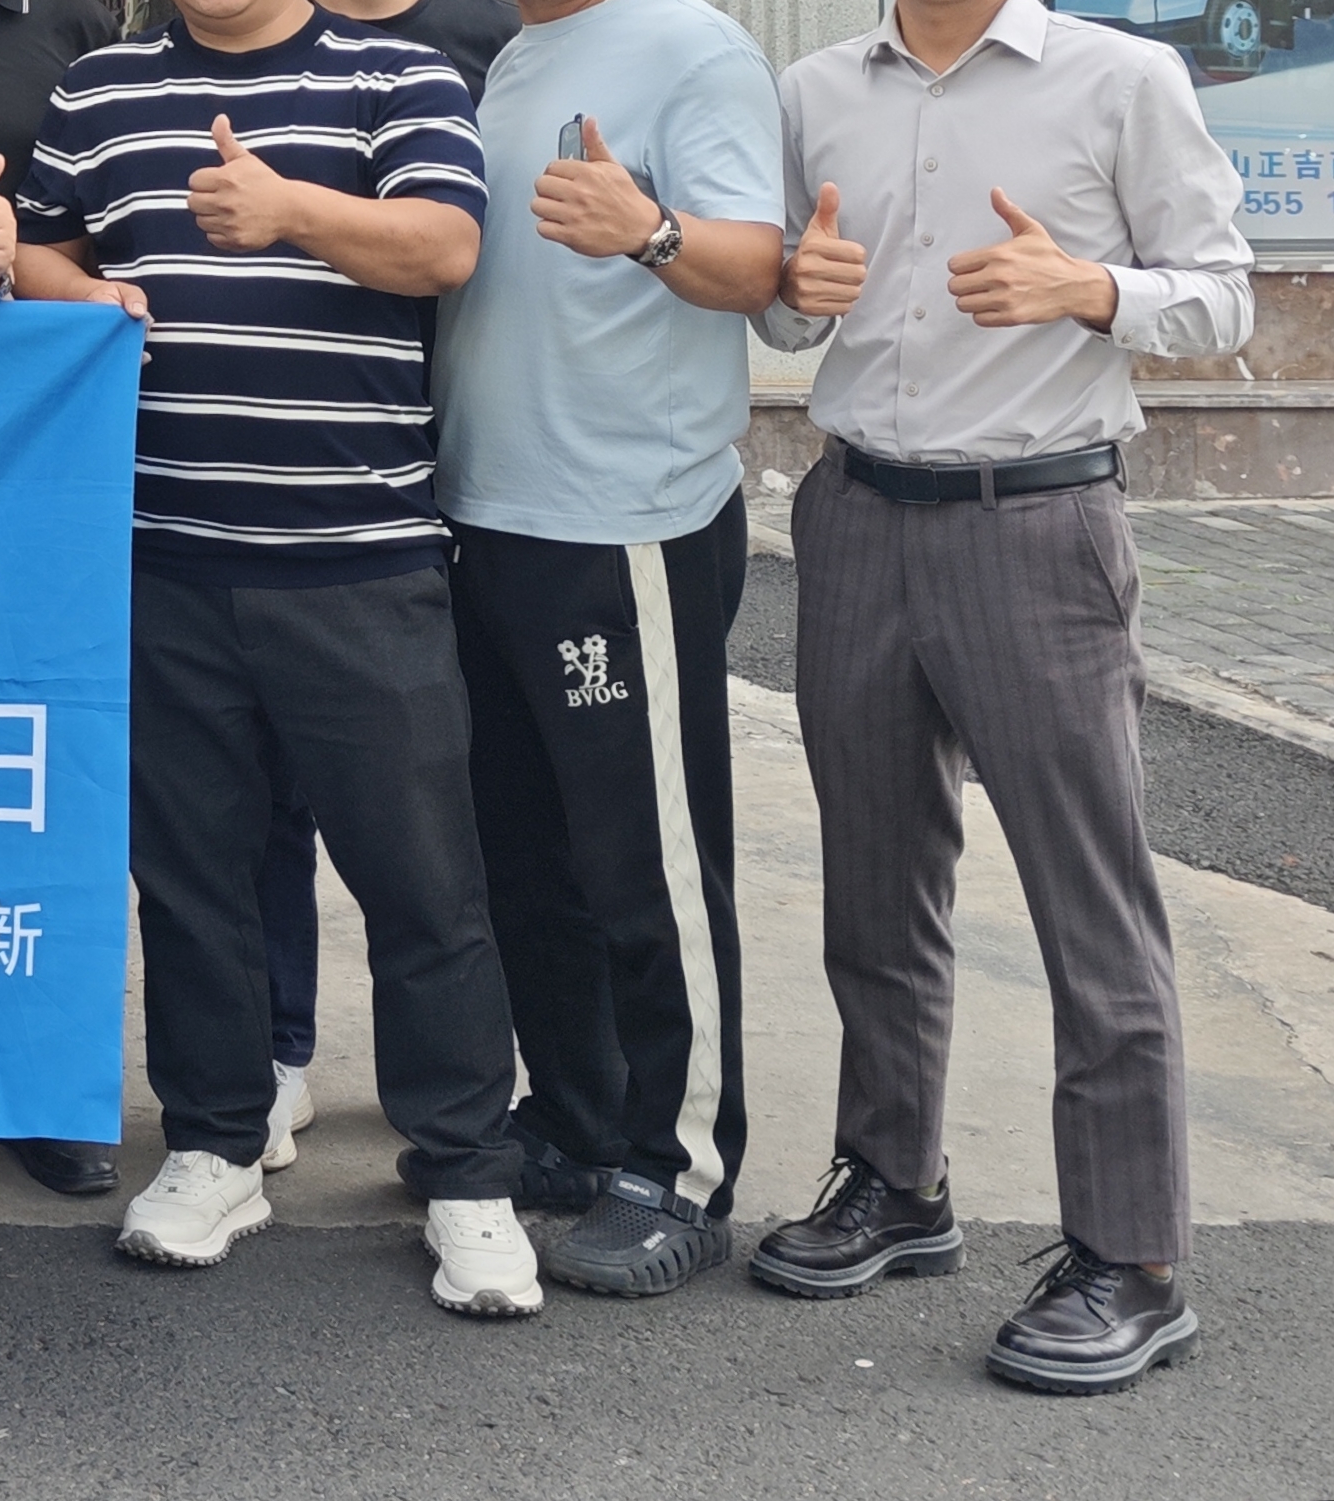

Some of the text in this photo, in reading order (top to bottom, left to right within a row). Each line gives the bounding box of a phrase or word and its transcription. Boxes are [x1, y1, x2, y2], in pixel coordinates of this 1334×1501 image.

[1232, 149, 1334, 180] 山正吉
[1234, 190, 1304, 215] 555
[565, 681, 629, 707] BVOG
